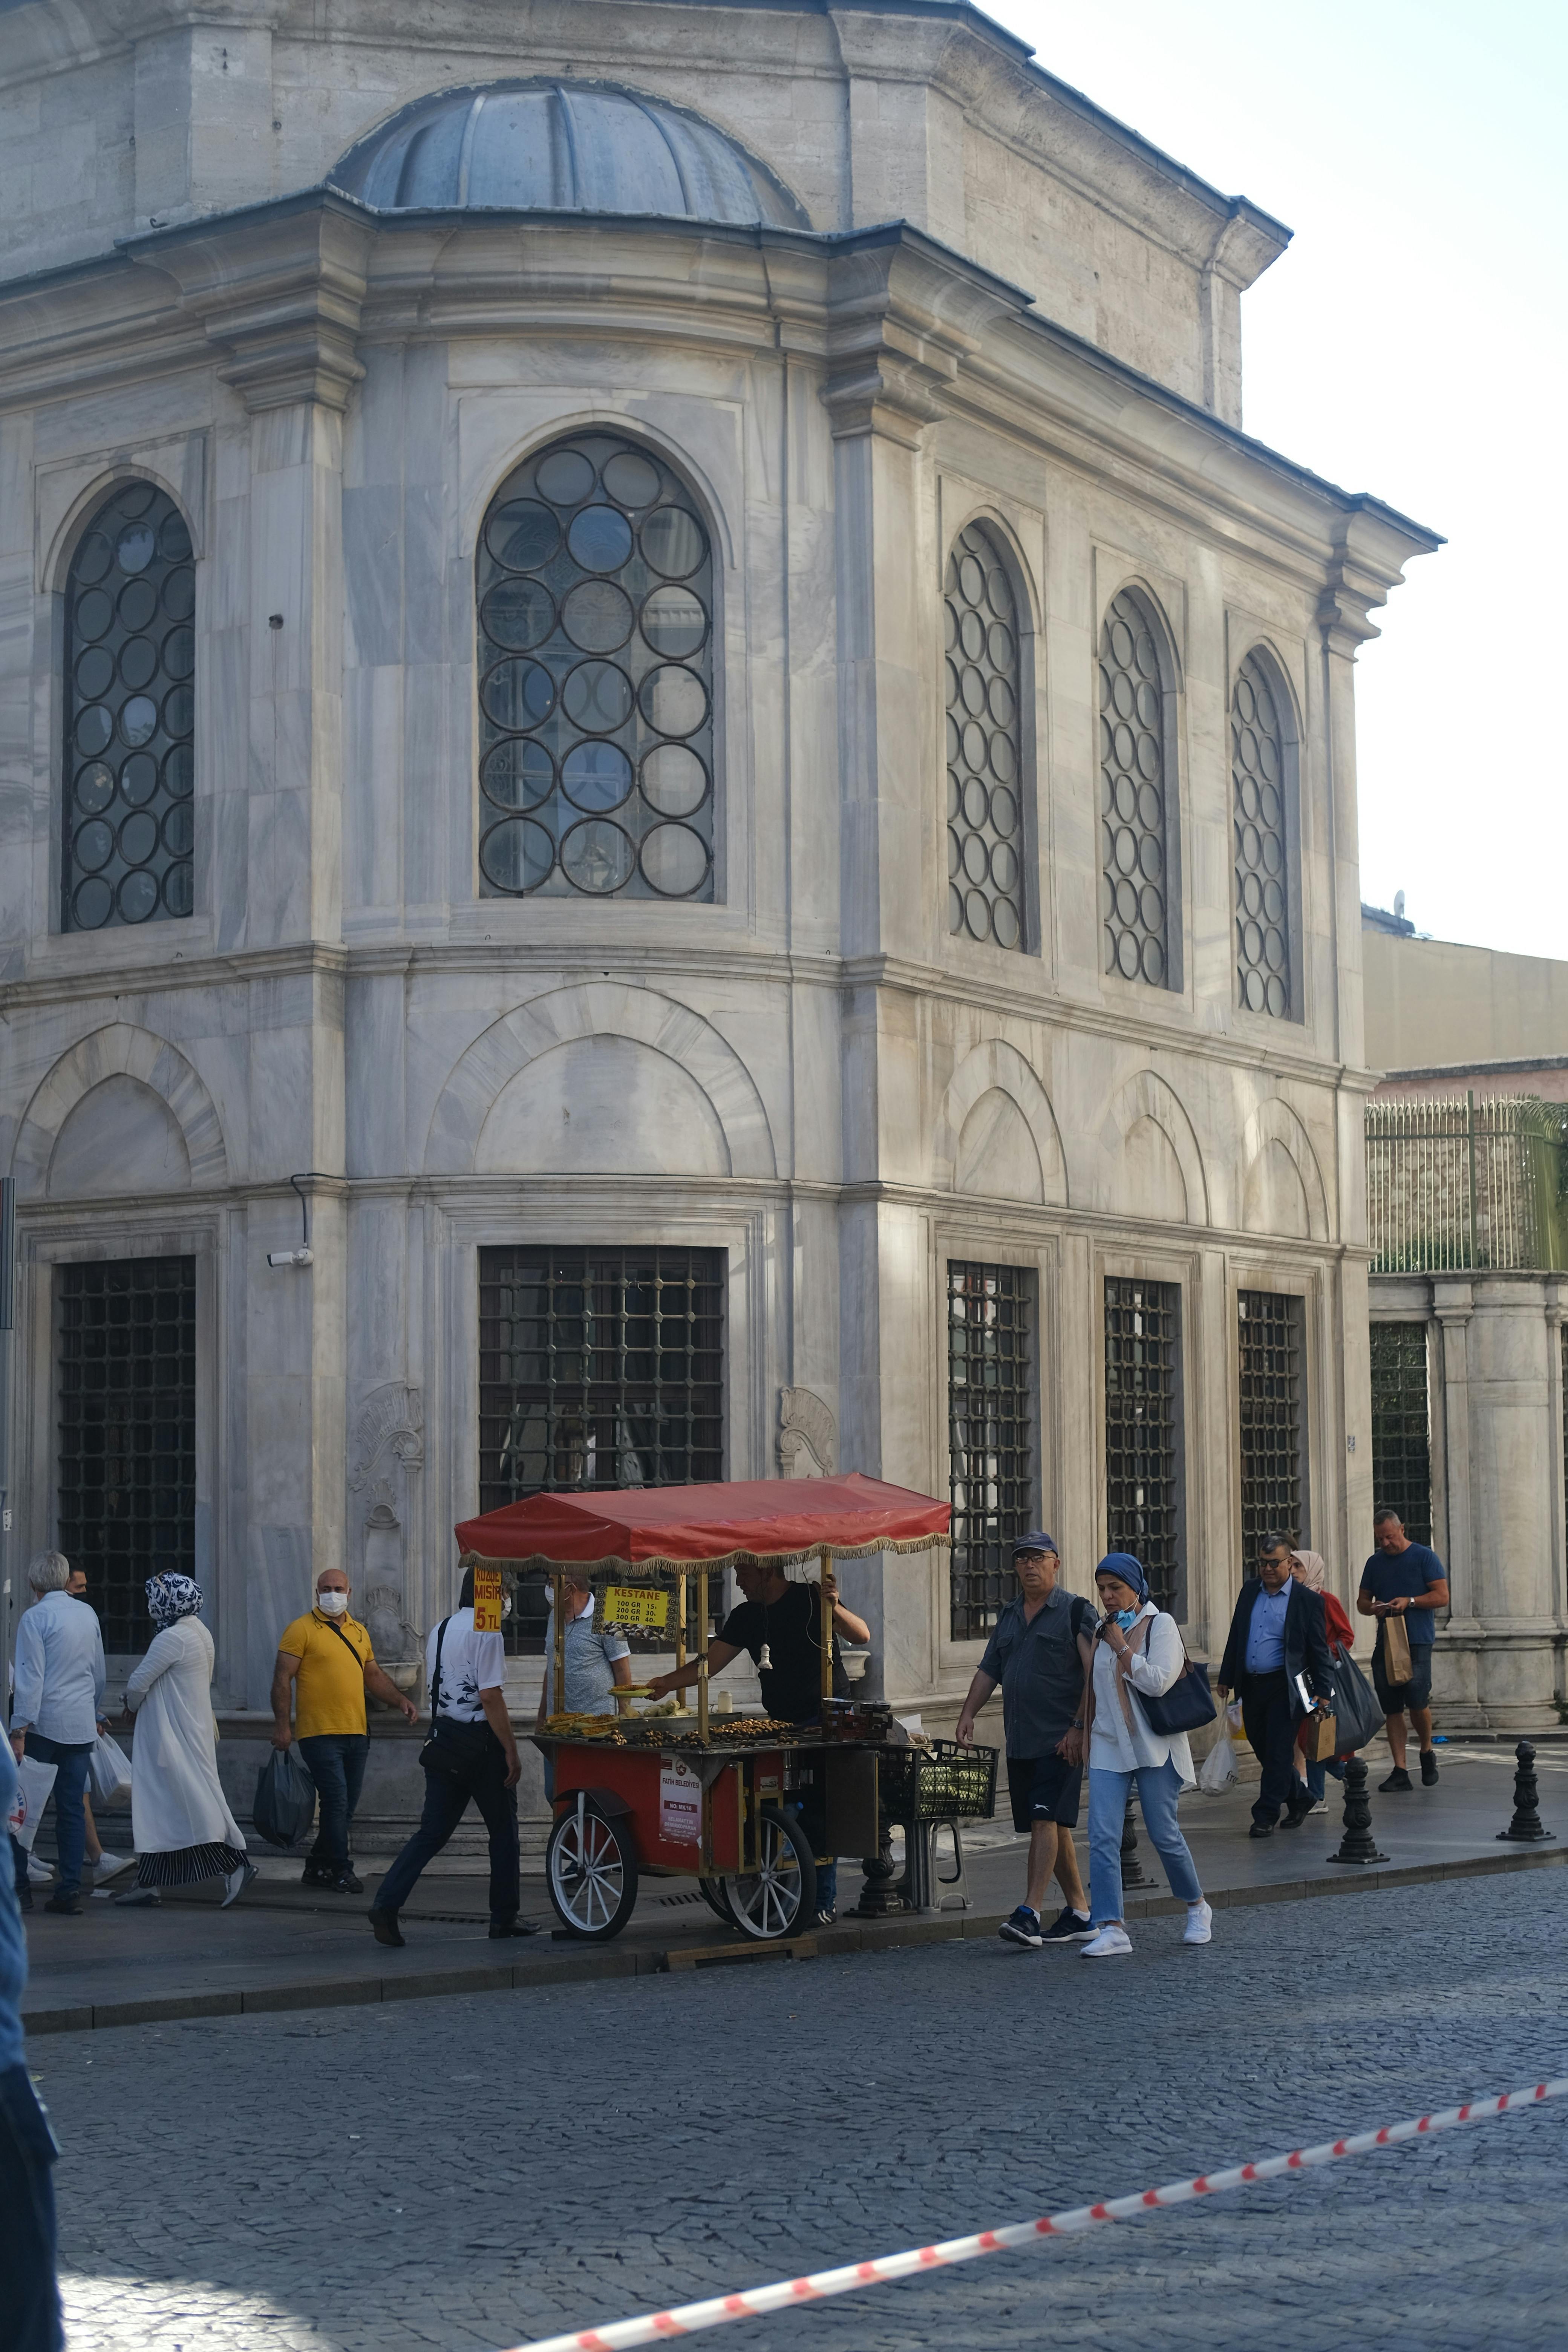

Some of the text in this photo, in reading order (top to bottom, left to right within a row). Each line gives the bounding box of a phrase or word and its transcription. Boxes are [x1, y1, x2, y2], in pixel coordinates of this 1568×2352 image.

[475, 1585, 501, 1600] MISIR
[614, 1588, 660, 1600] KESTANE
[476, 1607, 500, 1629] 5 TL
